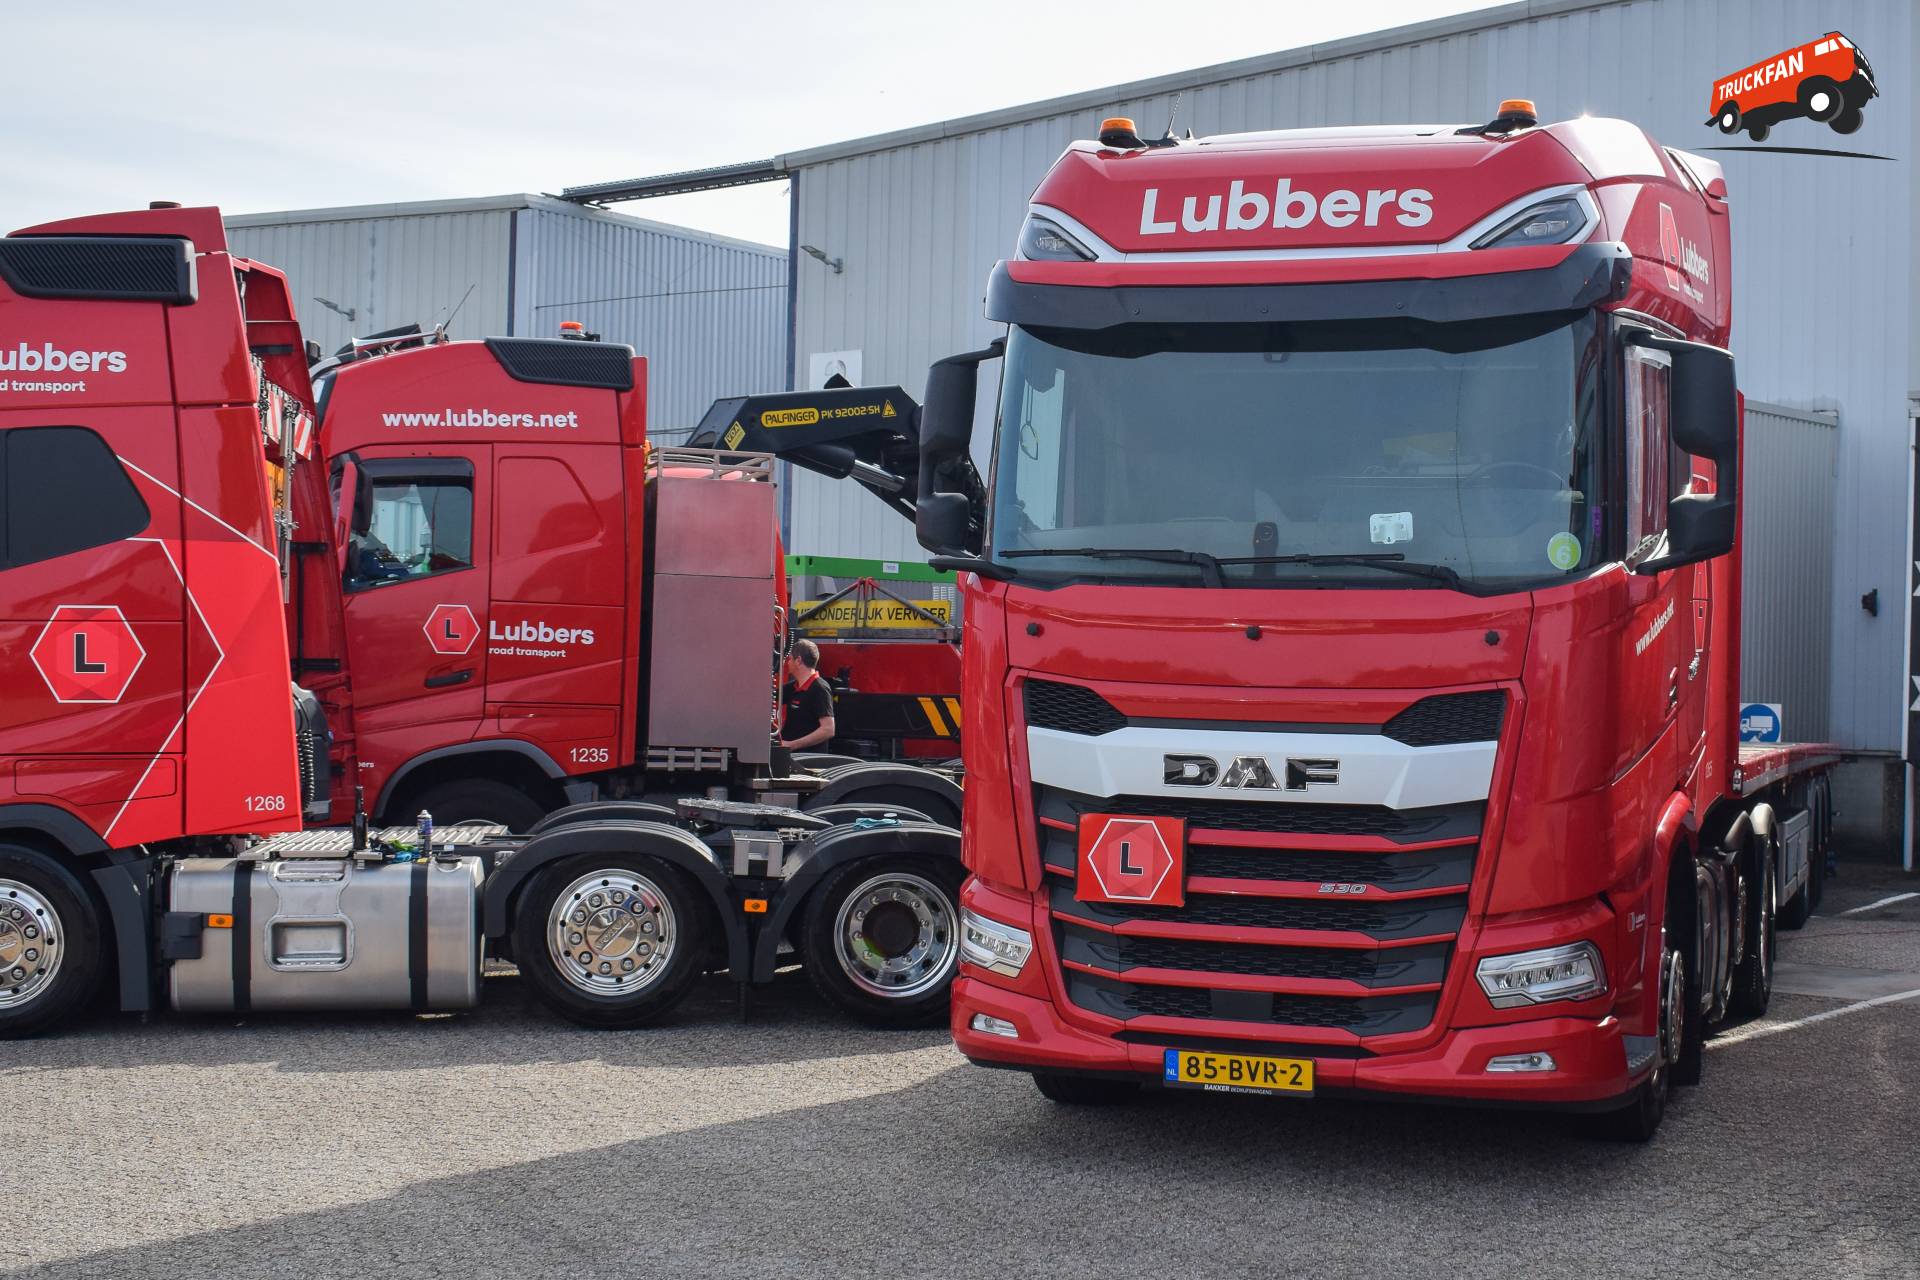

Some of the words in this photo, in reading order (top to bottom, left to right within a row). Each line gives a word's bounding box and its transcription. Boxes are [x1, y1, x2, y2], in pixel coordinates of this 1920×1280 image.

[1139, 178, 1434, 235] Lubbers
[1681, 237, 1709, 285] Lubbers
[12, 380, 86, 393] transport
[382, 409, 578, 427] www.lubbers.net
[765, 410, 815, 424] PALFINGER
[821, 411, 834, 420] PK
[445, 618, 460, 639] L
[489, 620, 594, 645] Lubbers
[74, 632, 106, 674] L
[489, 646, 514, 655] road
[516, 648, 566, 658] transport
[570, 748, 609, 762] 1235
[1163, 754, 1341, 792] DAF
[245, 795, 285, 811] 1268
[1120, 841, 1143, 875] L
[1167, 1068, 1177, 1076] NL
[1186, 1056, 1303, 1086] 85-BVR-2
[1204, 1084, 1230, 1092] BAKKER
